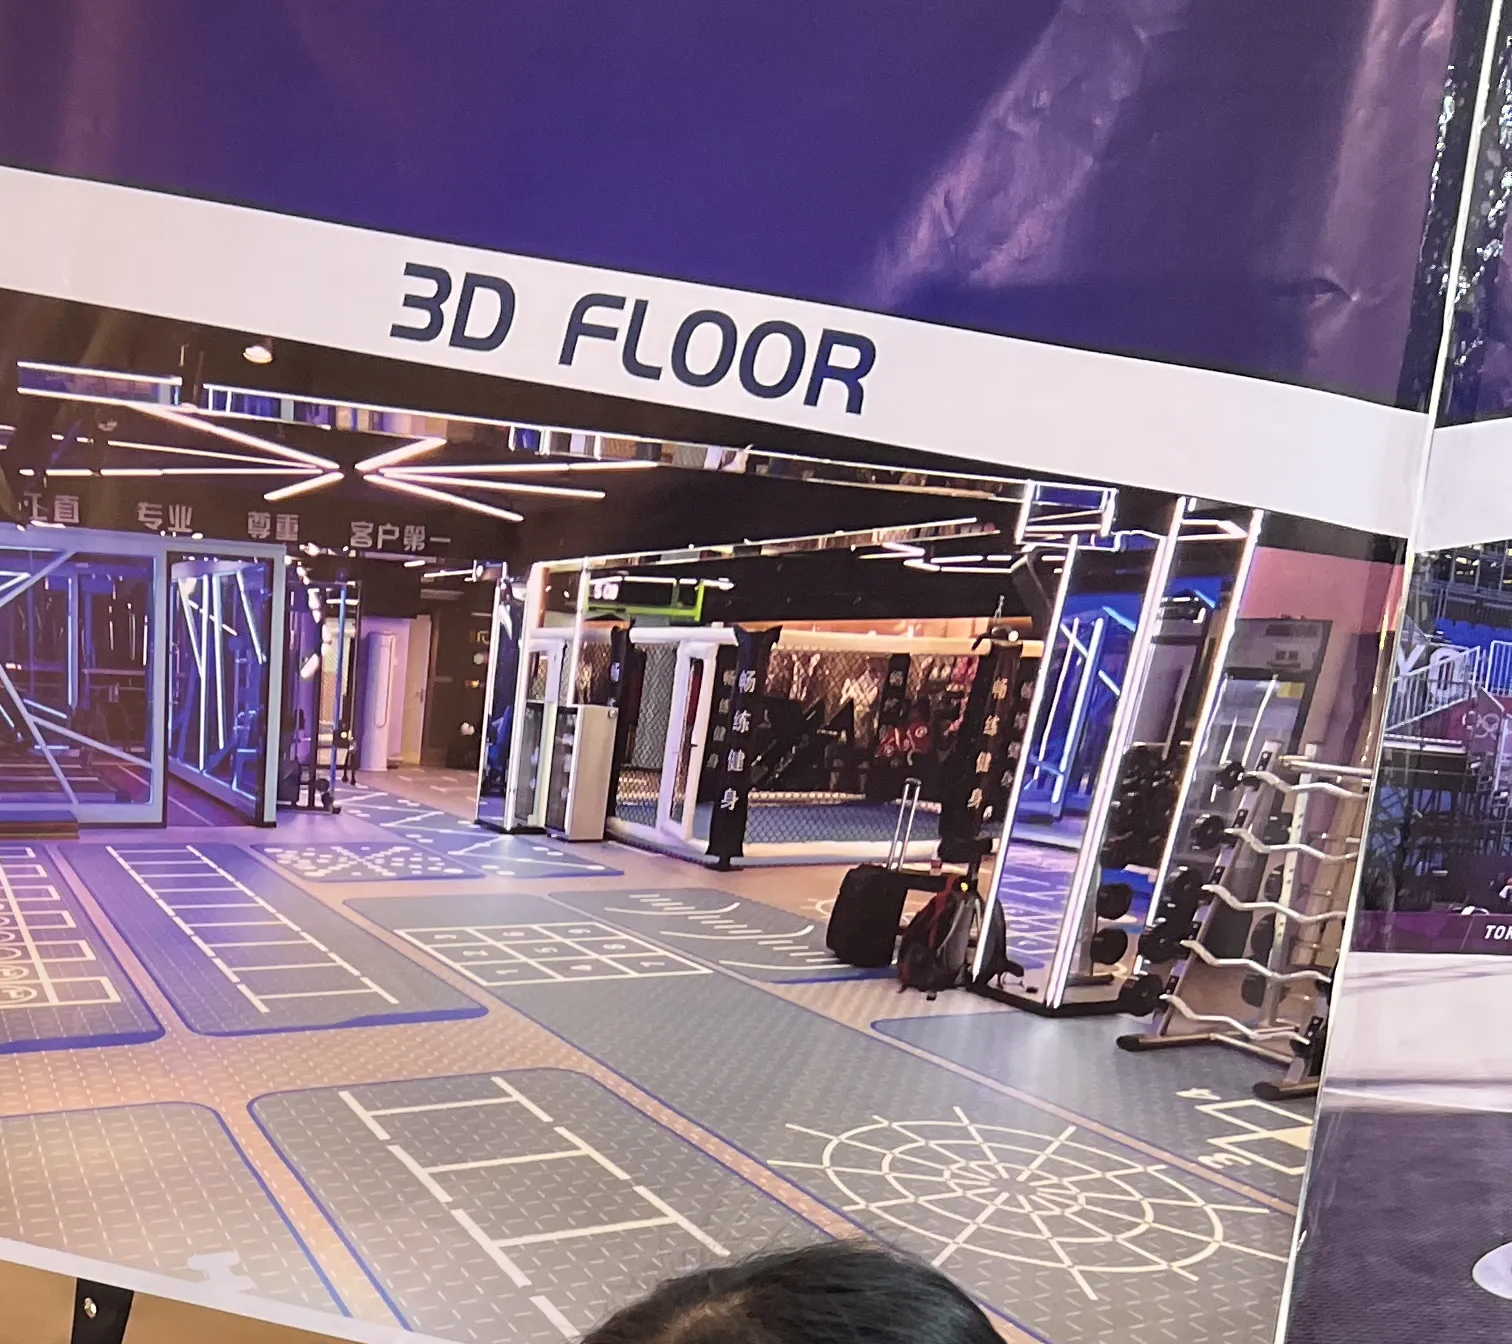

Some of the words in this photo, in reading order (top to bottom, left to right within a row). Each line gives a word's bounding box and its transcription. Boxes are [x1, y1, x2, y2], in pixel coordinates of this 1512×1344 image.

[389, 261, 516, 353] 3D
[557, 291, 878, 415] FLOOR
[137, 502, 194, 534] 专业
[247, 511, 300, 543] 尊重
[350, 521, 452, 552] 客户第一
